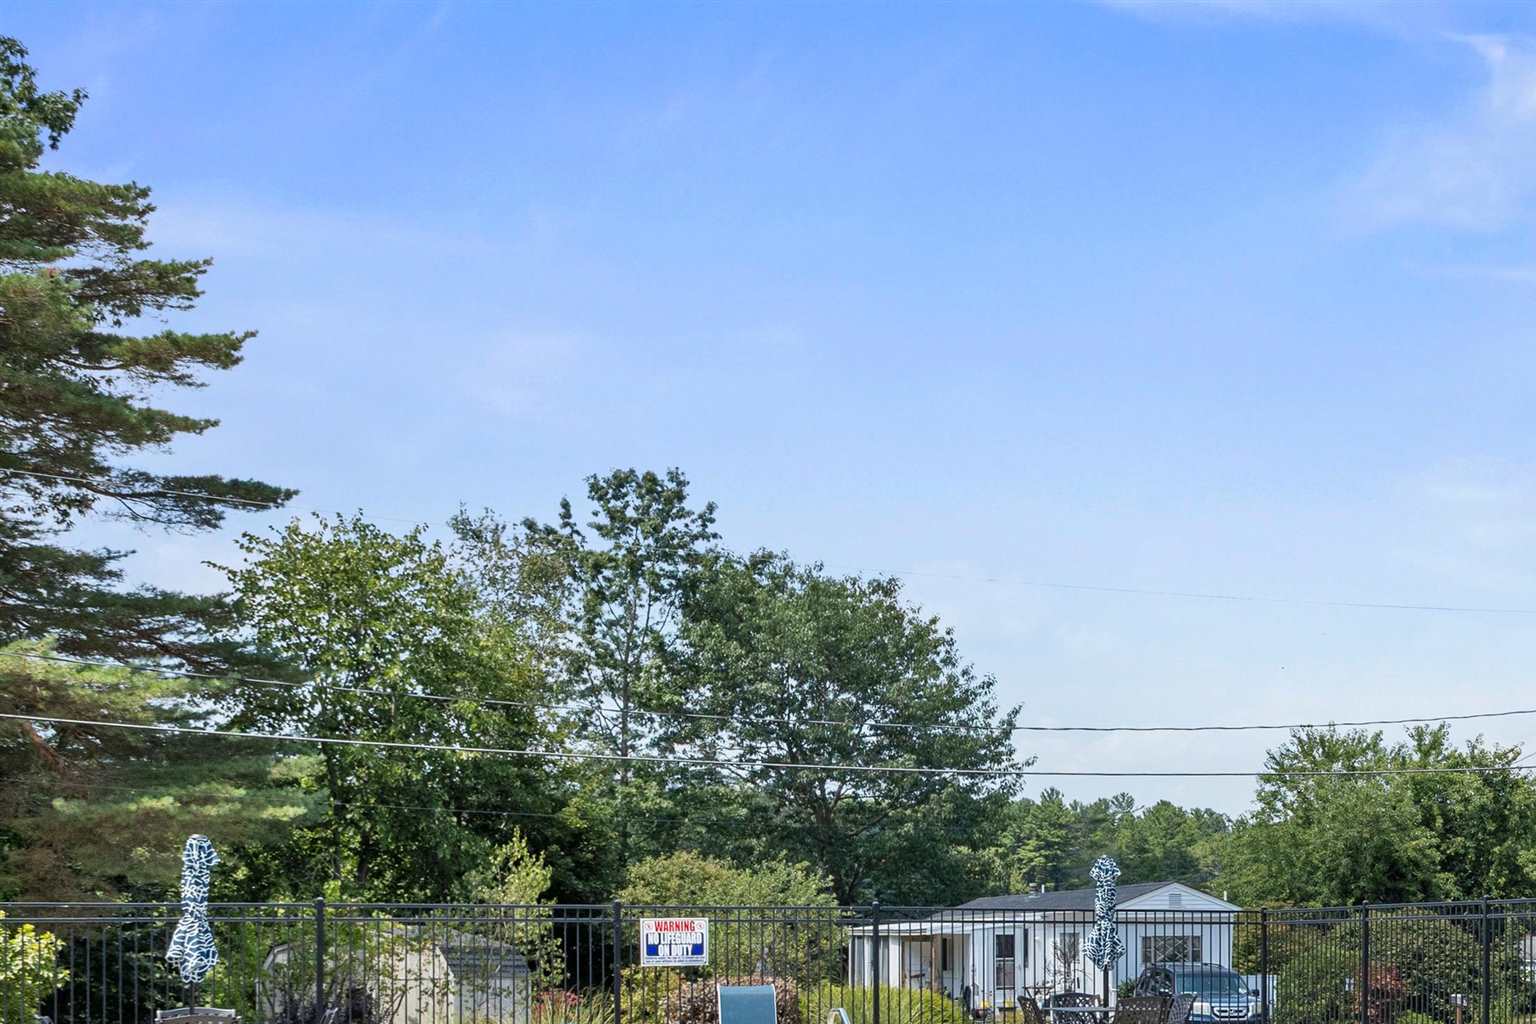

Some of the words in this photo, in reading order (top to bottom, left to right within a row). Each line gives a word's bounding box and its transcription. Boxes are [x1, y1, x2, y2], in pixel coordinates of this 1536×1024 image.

[655, 920, 695, 932] WARNING
[648, 933, 659, 944] NO
[661, 932, 702, 944] LIFEGUARD
[658, 944, 670, 956] ON
[671, 944, 693, 956] DUTY
